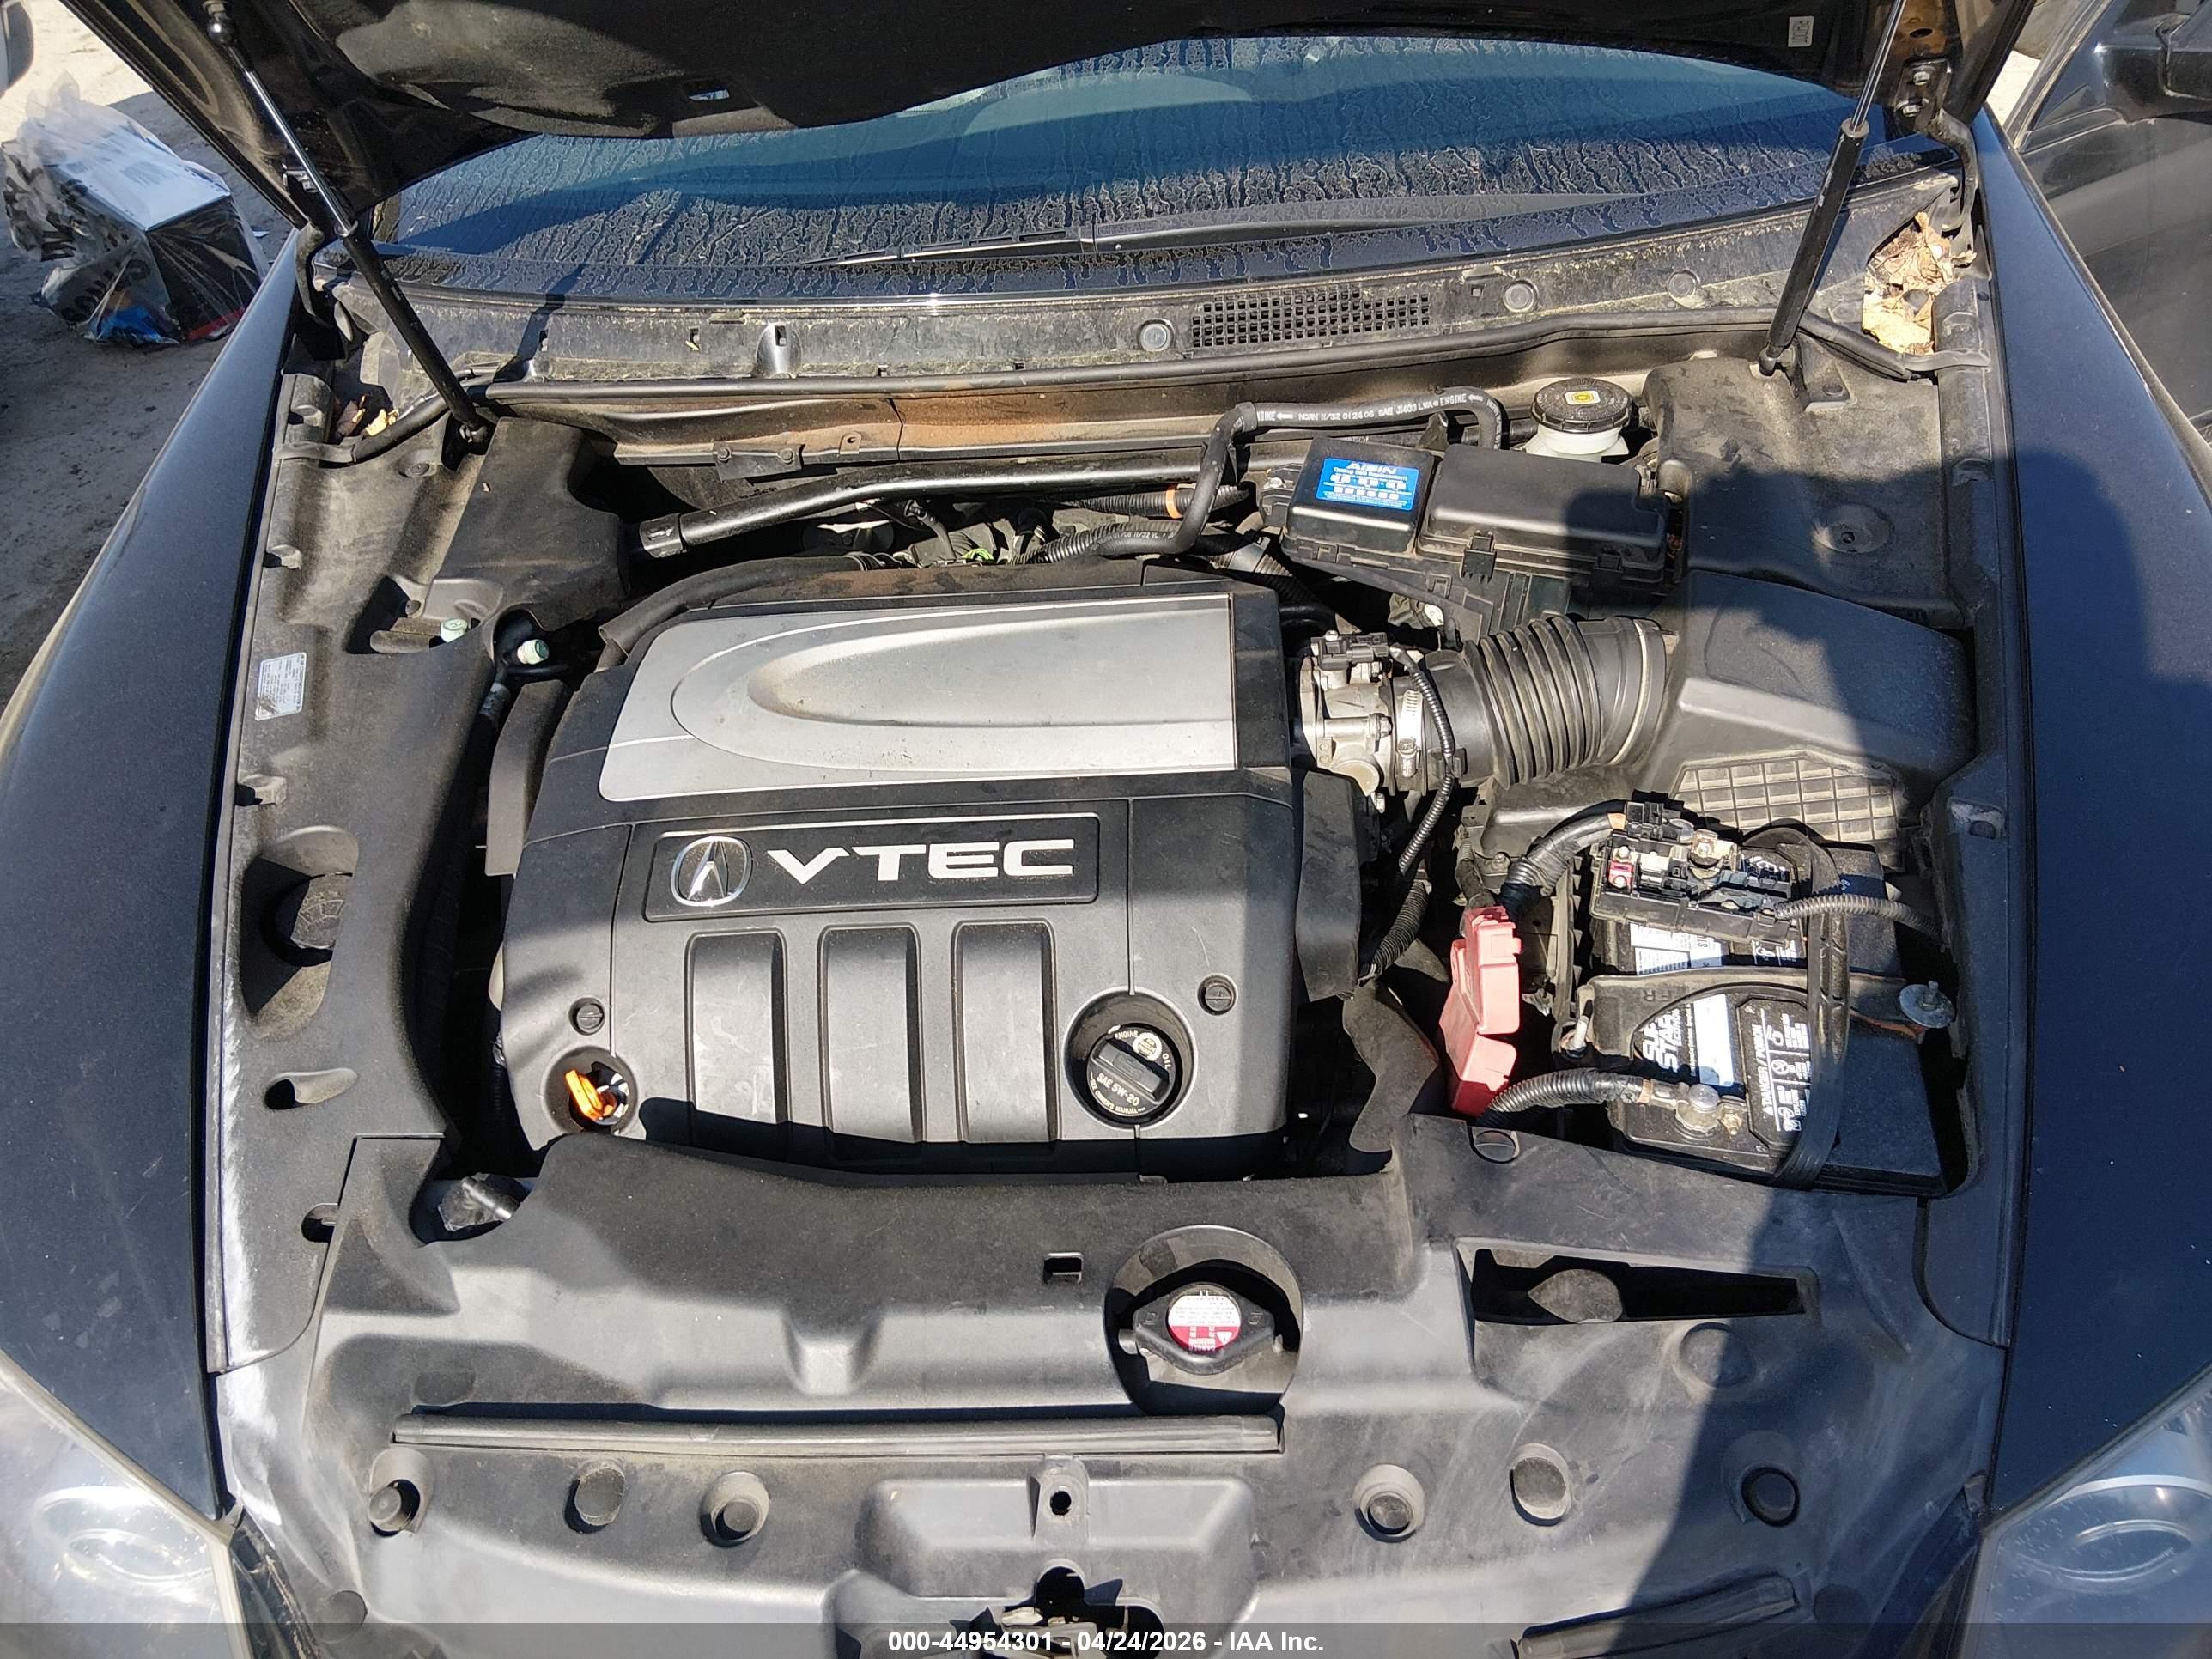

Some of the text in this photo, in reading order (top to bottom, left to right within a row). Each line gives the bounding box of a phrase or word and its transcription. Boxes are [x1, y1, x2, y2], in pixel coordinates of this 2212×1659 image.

[1257, 411, 1276, 421] NGINE
[1440, 394, 1467, 406] ENGINE
[1346, 463, 1397, 475] AISIN
[767, 839, 1074, 884] VTEC
[1114, 1030, 1139, 1039] ENGINE
[1642, 1020, 1659, 1061] SUP
[1655, 1011, 1680, 1073] STAR
[1751, 1024, 1765, 1055] POISON
[1162, 1053, 1172, 1069] OIL
[1095, 1091, 1115, 1109] OWNER'S
[1097, 1073, 1140, 1106] SAE 5W-20
[1757, 1065, 1775, 1108] DANGER
